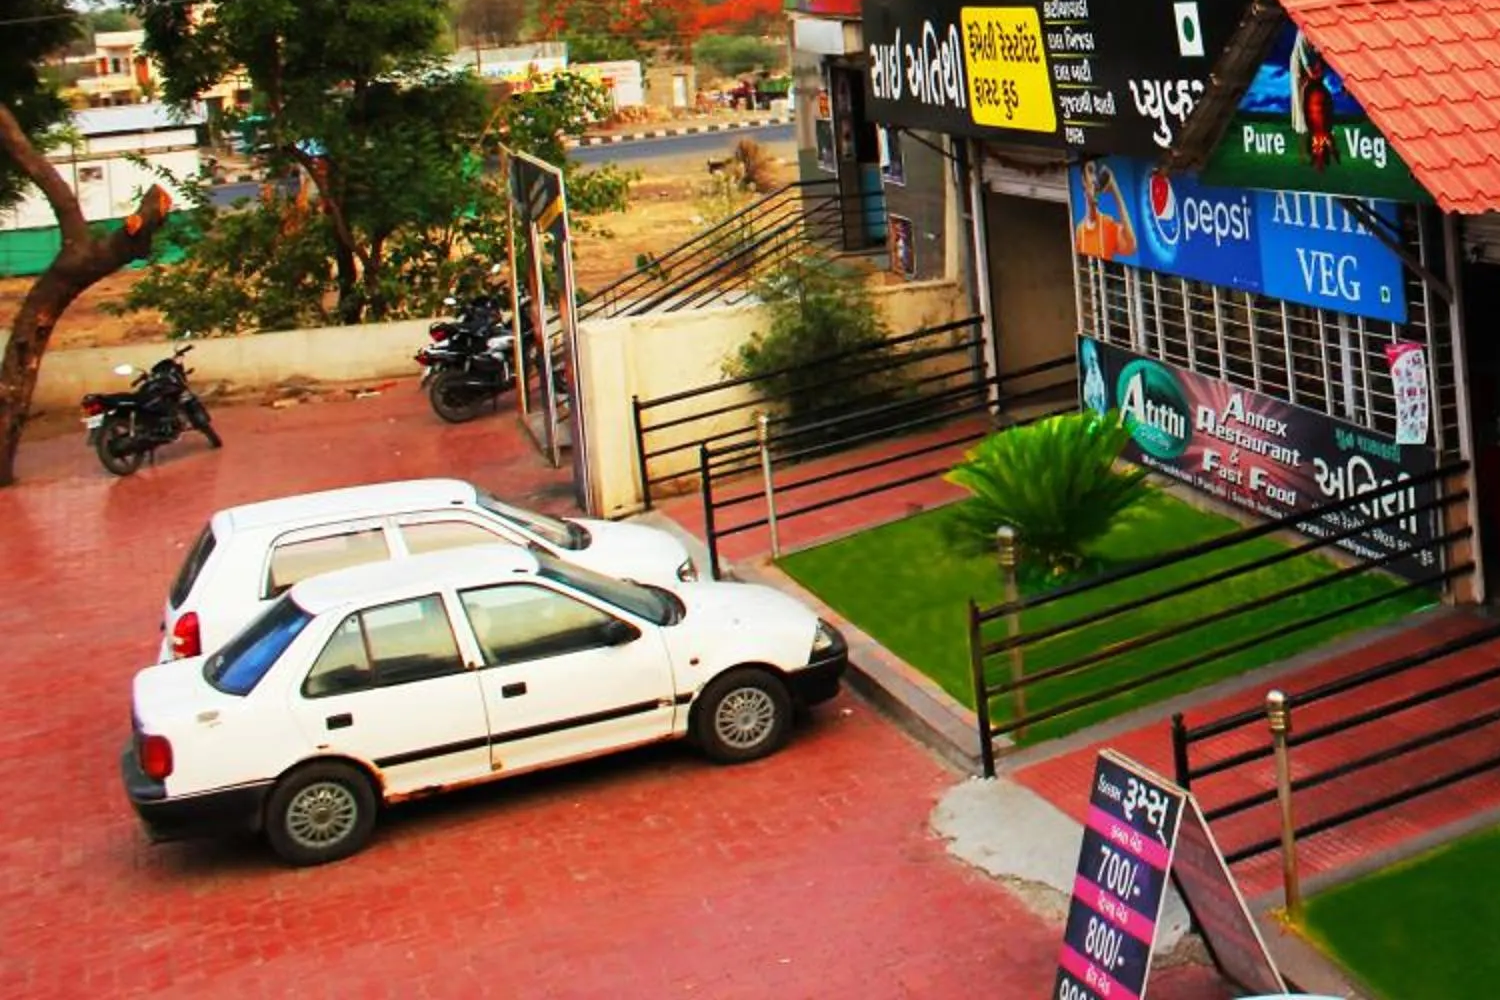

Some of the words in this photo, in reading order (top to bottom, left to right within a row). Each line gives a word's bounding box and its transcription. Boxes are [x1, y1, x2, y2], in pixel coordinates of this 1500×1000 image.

[1243, 125, 1286, 155] Pure
[1344, 128, 1387, 168] Veg
[1183, 195, 1251, 247] pepsi
[1296, 247, 1361, 301] VEG
[1196, 404, 1301, 468] Restaurant
[1221, 392, 1288, 438] Annex
[1202, 448, 1243, 486] Fast
[1250, 466, 1297, 507] Food
